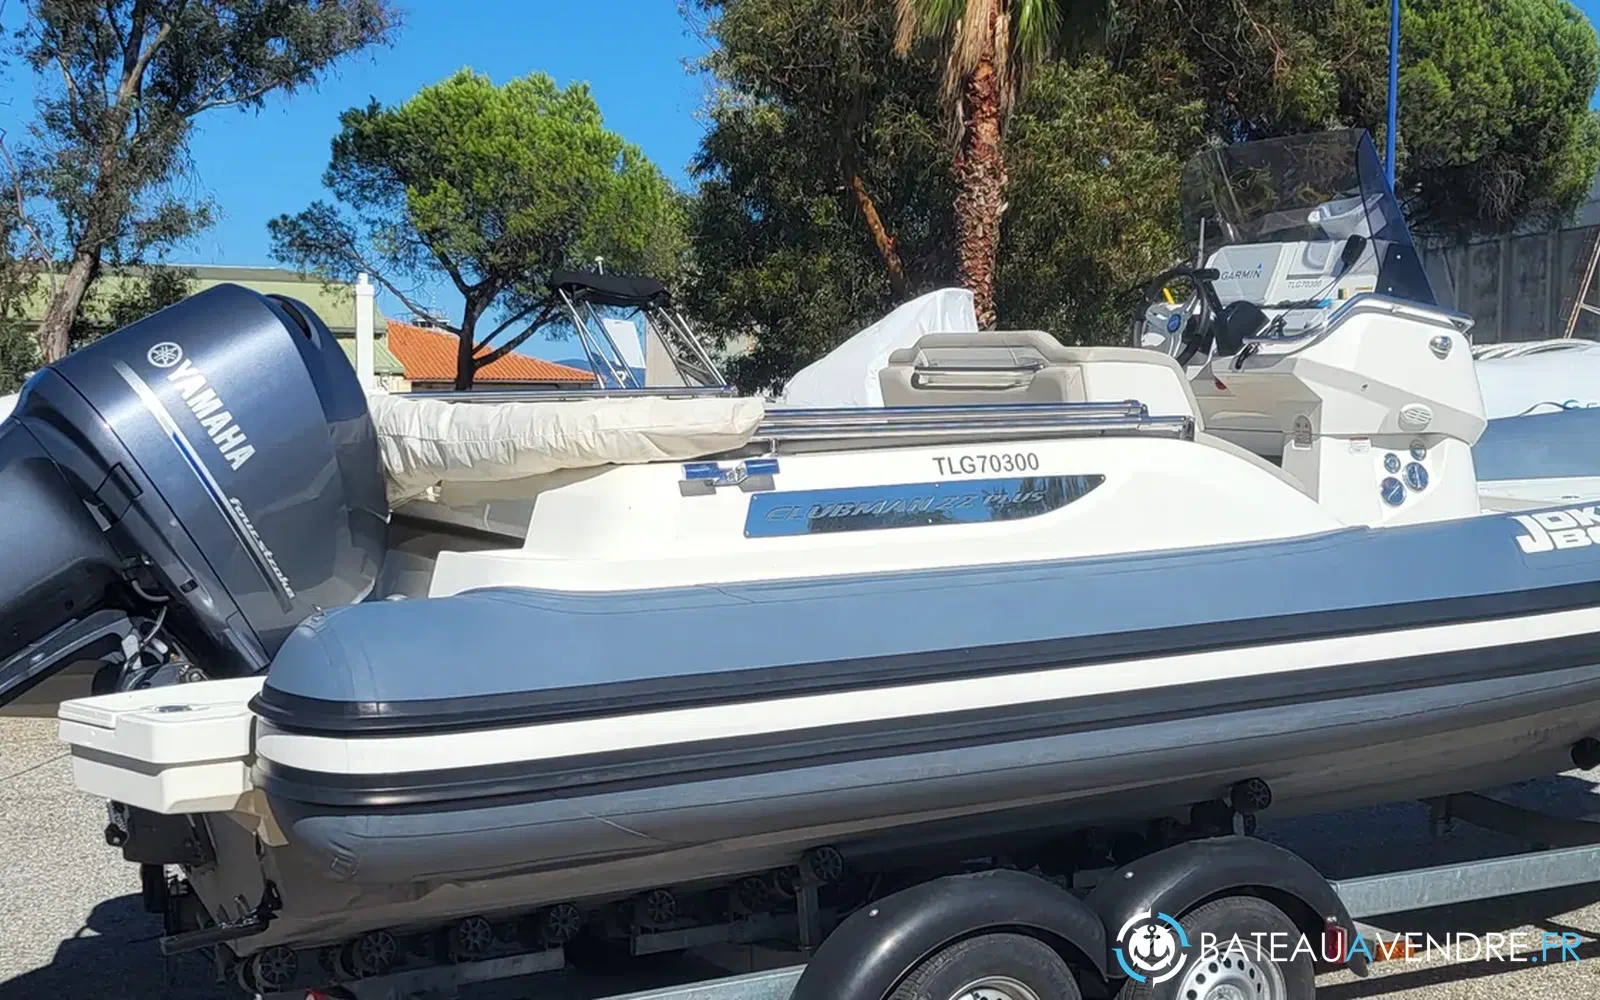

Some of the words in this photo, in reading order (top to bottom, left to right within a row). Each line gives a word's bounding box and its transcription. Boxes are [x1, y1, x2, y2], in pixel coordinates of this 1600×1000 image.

[1221, 269, 1262, 281] GARMIN
[167, 359, 256, 471] YAMAHA
[932, 452, 1039, 475] TLG70300
[763, 496, 935, 522] CLUBMAN
[229, 497, 296, 599] fourstroke
[1510, 505, 1600, 554] JOK
